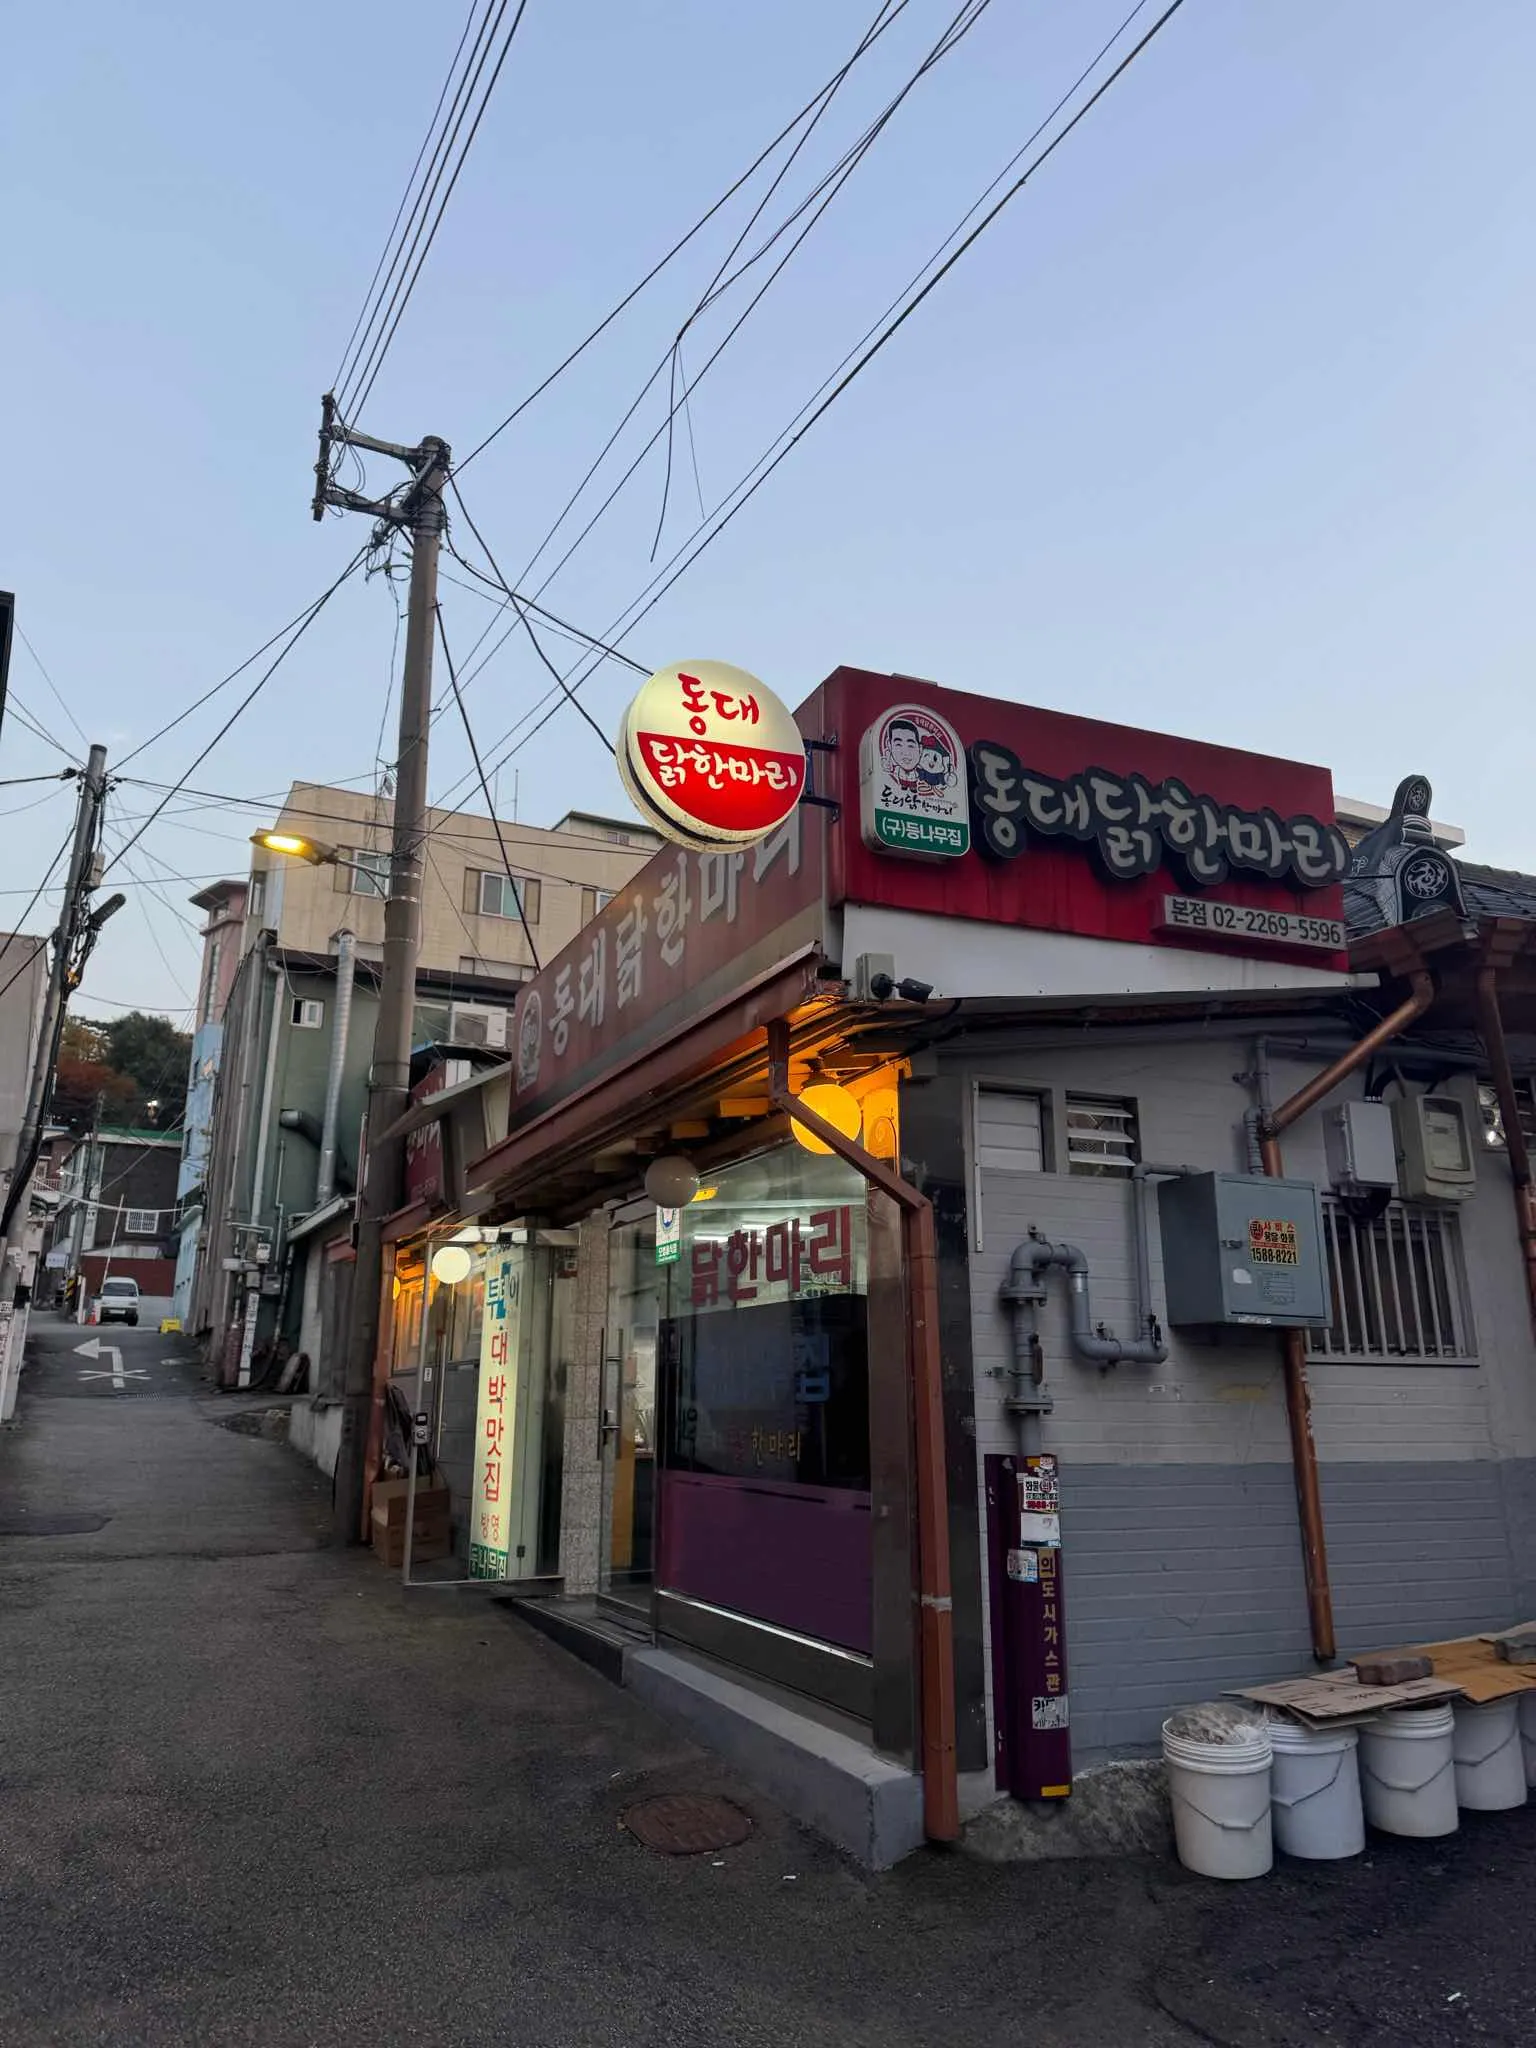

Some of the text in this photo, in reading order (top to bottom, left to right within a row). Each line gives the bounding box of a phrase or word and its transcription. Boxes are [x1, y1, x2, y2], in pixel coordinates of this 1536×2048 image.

[678, 672, 760, 735] 동대
[649, 740, 797, 790] 닭한마리
[881, 816, 962, 847] (구)등나무집
[1171, 899, 1342, 944] 본점 02-2269-5596
[1252, 1247, 1297, 1264] 1588-8221
[1042, 1581, 1061, 1693] 도시가스관
